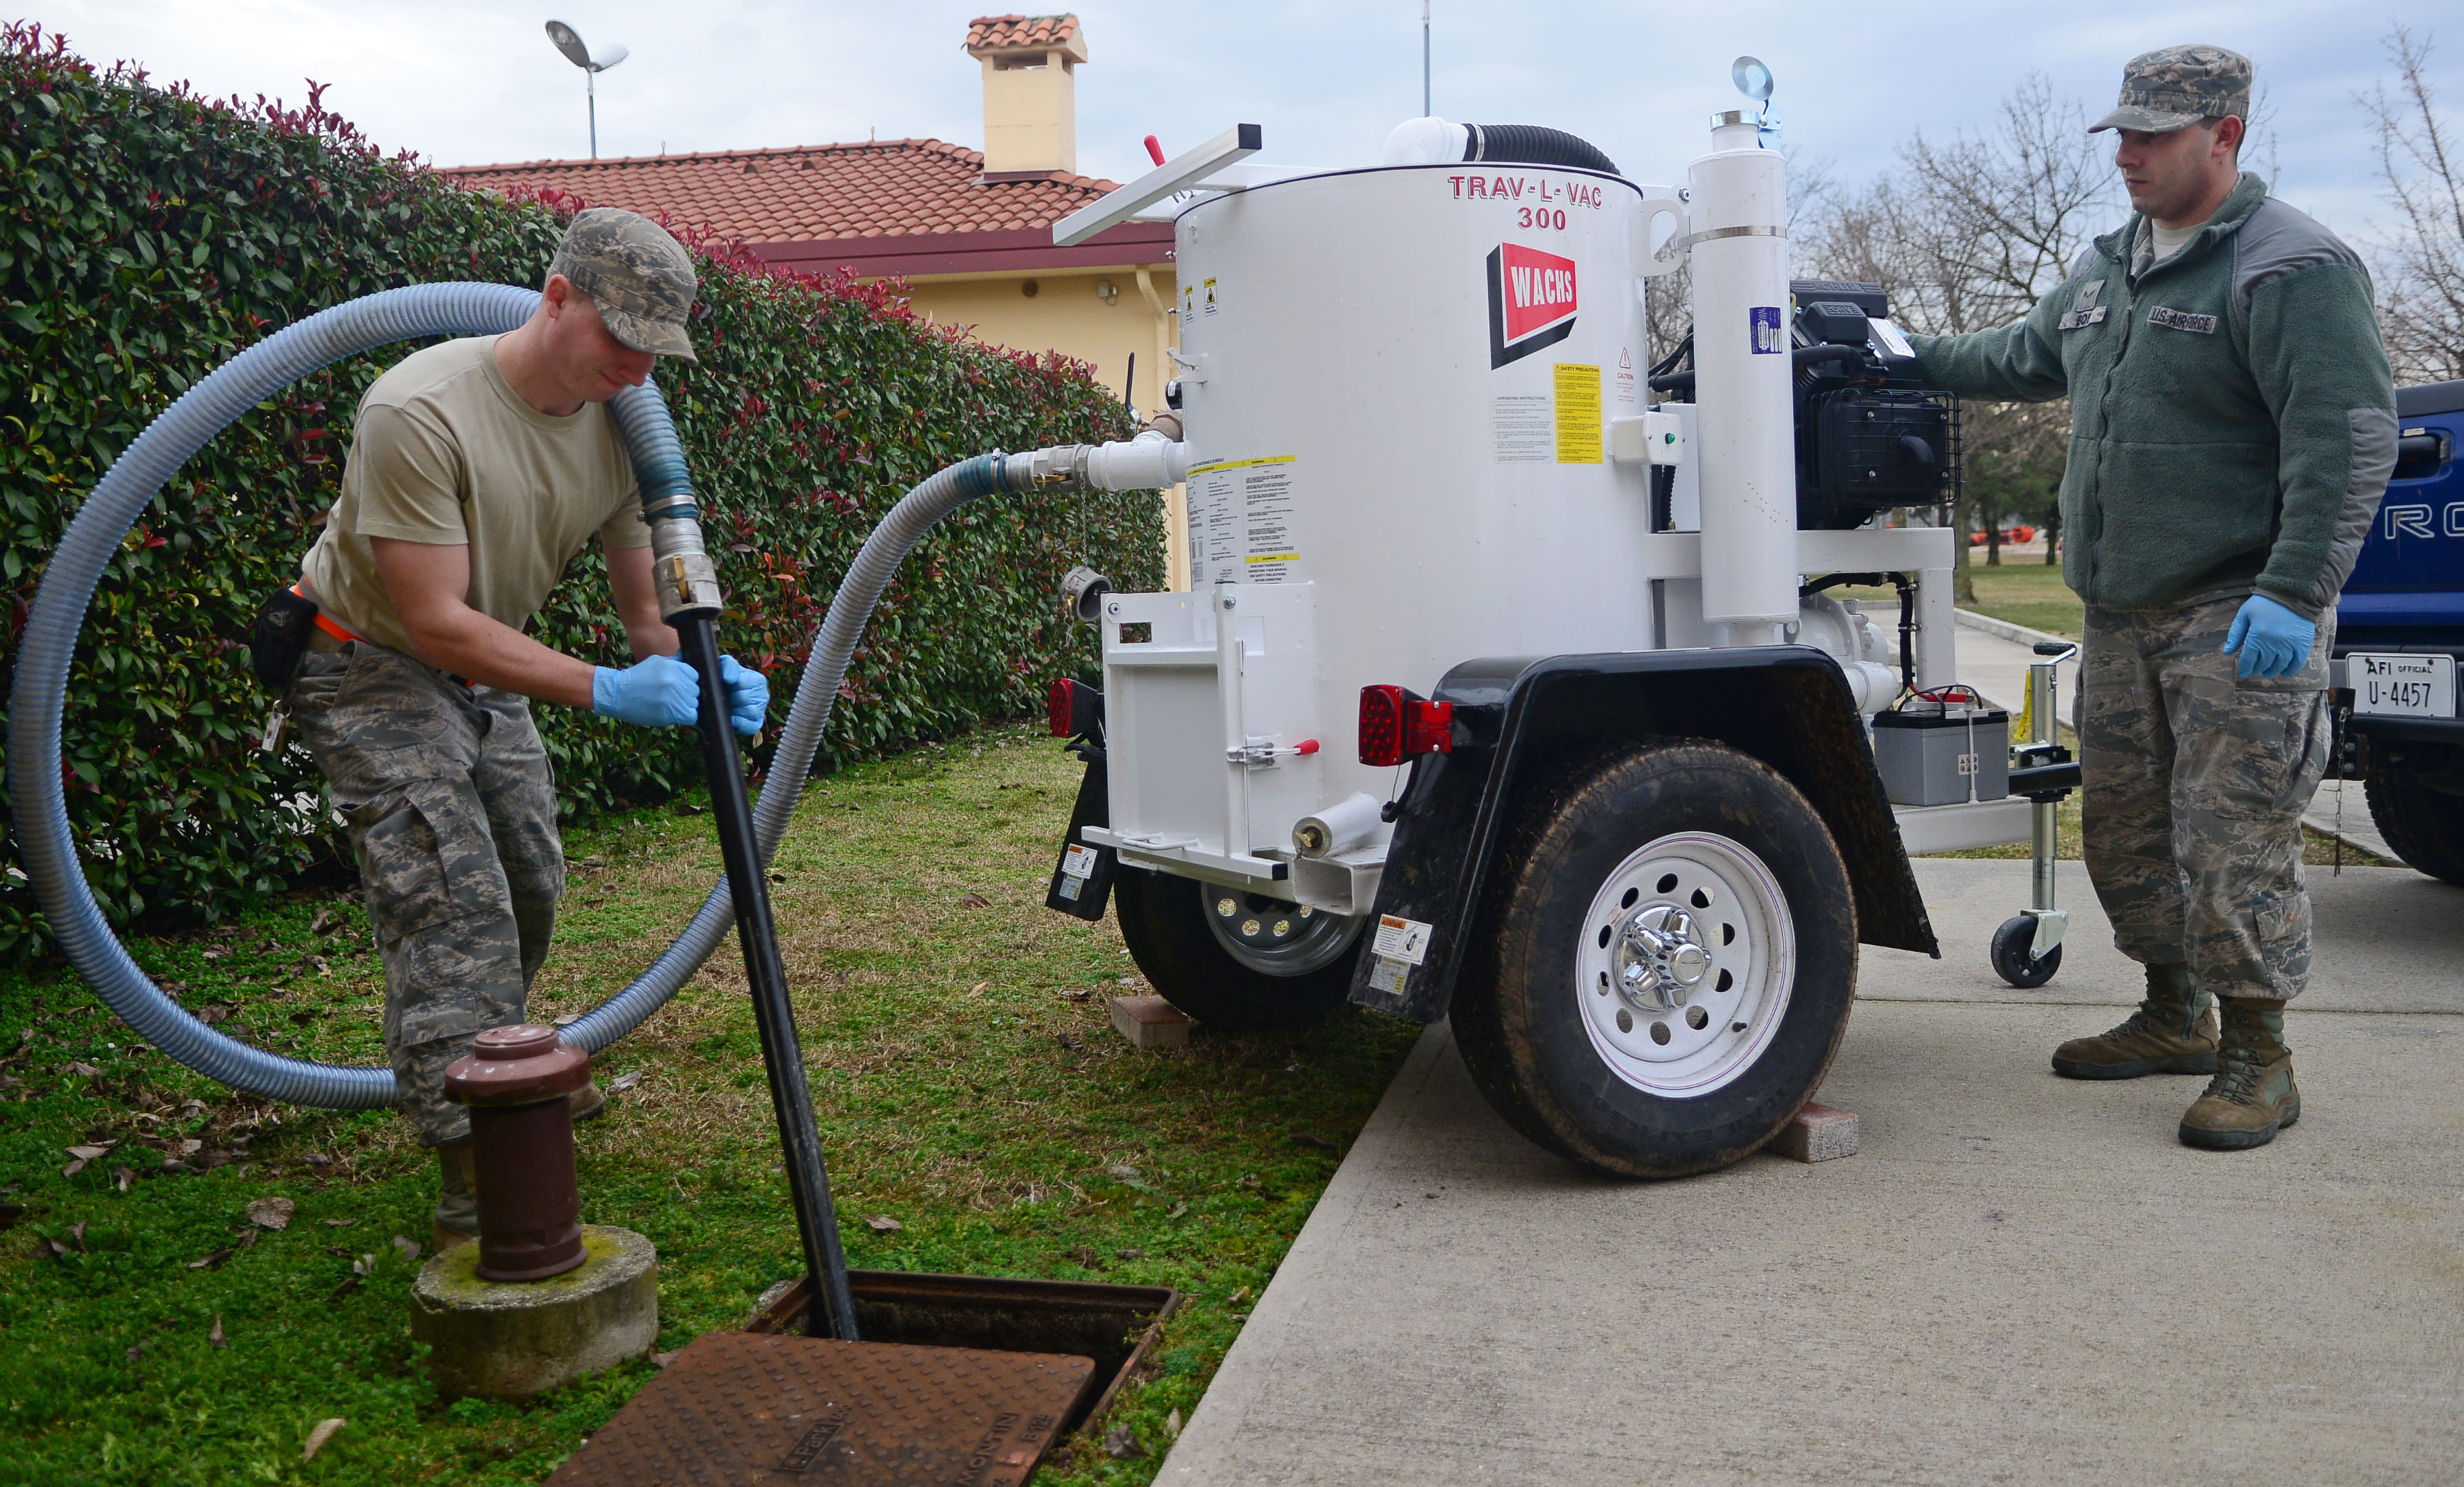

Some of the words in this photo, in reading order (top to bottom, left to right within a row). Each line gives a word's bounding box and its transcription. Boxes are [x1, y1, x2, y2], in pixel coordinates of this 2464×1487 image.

[1518, 207, 1566, 231] 300
[1510, 266, 1573, 308] WACHS
[2367, 661, 2392, 675] AFI
[2398, 665, 2433, 674] OFFICIAL
[2369, 681, 2431, 708] U-4457
[794, 1426, 835, 1457] Park
